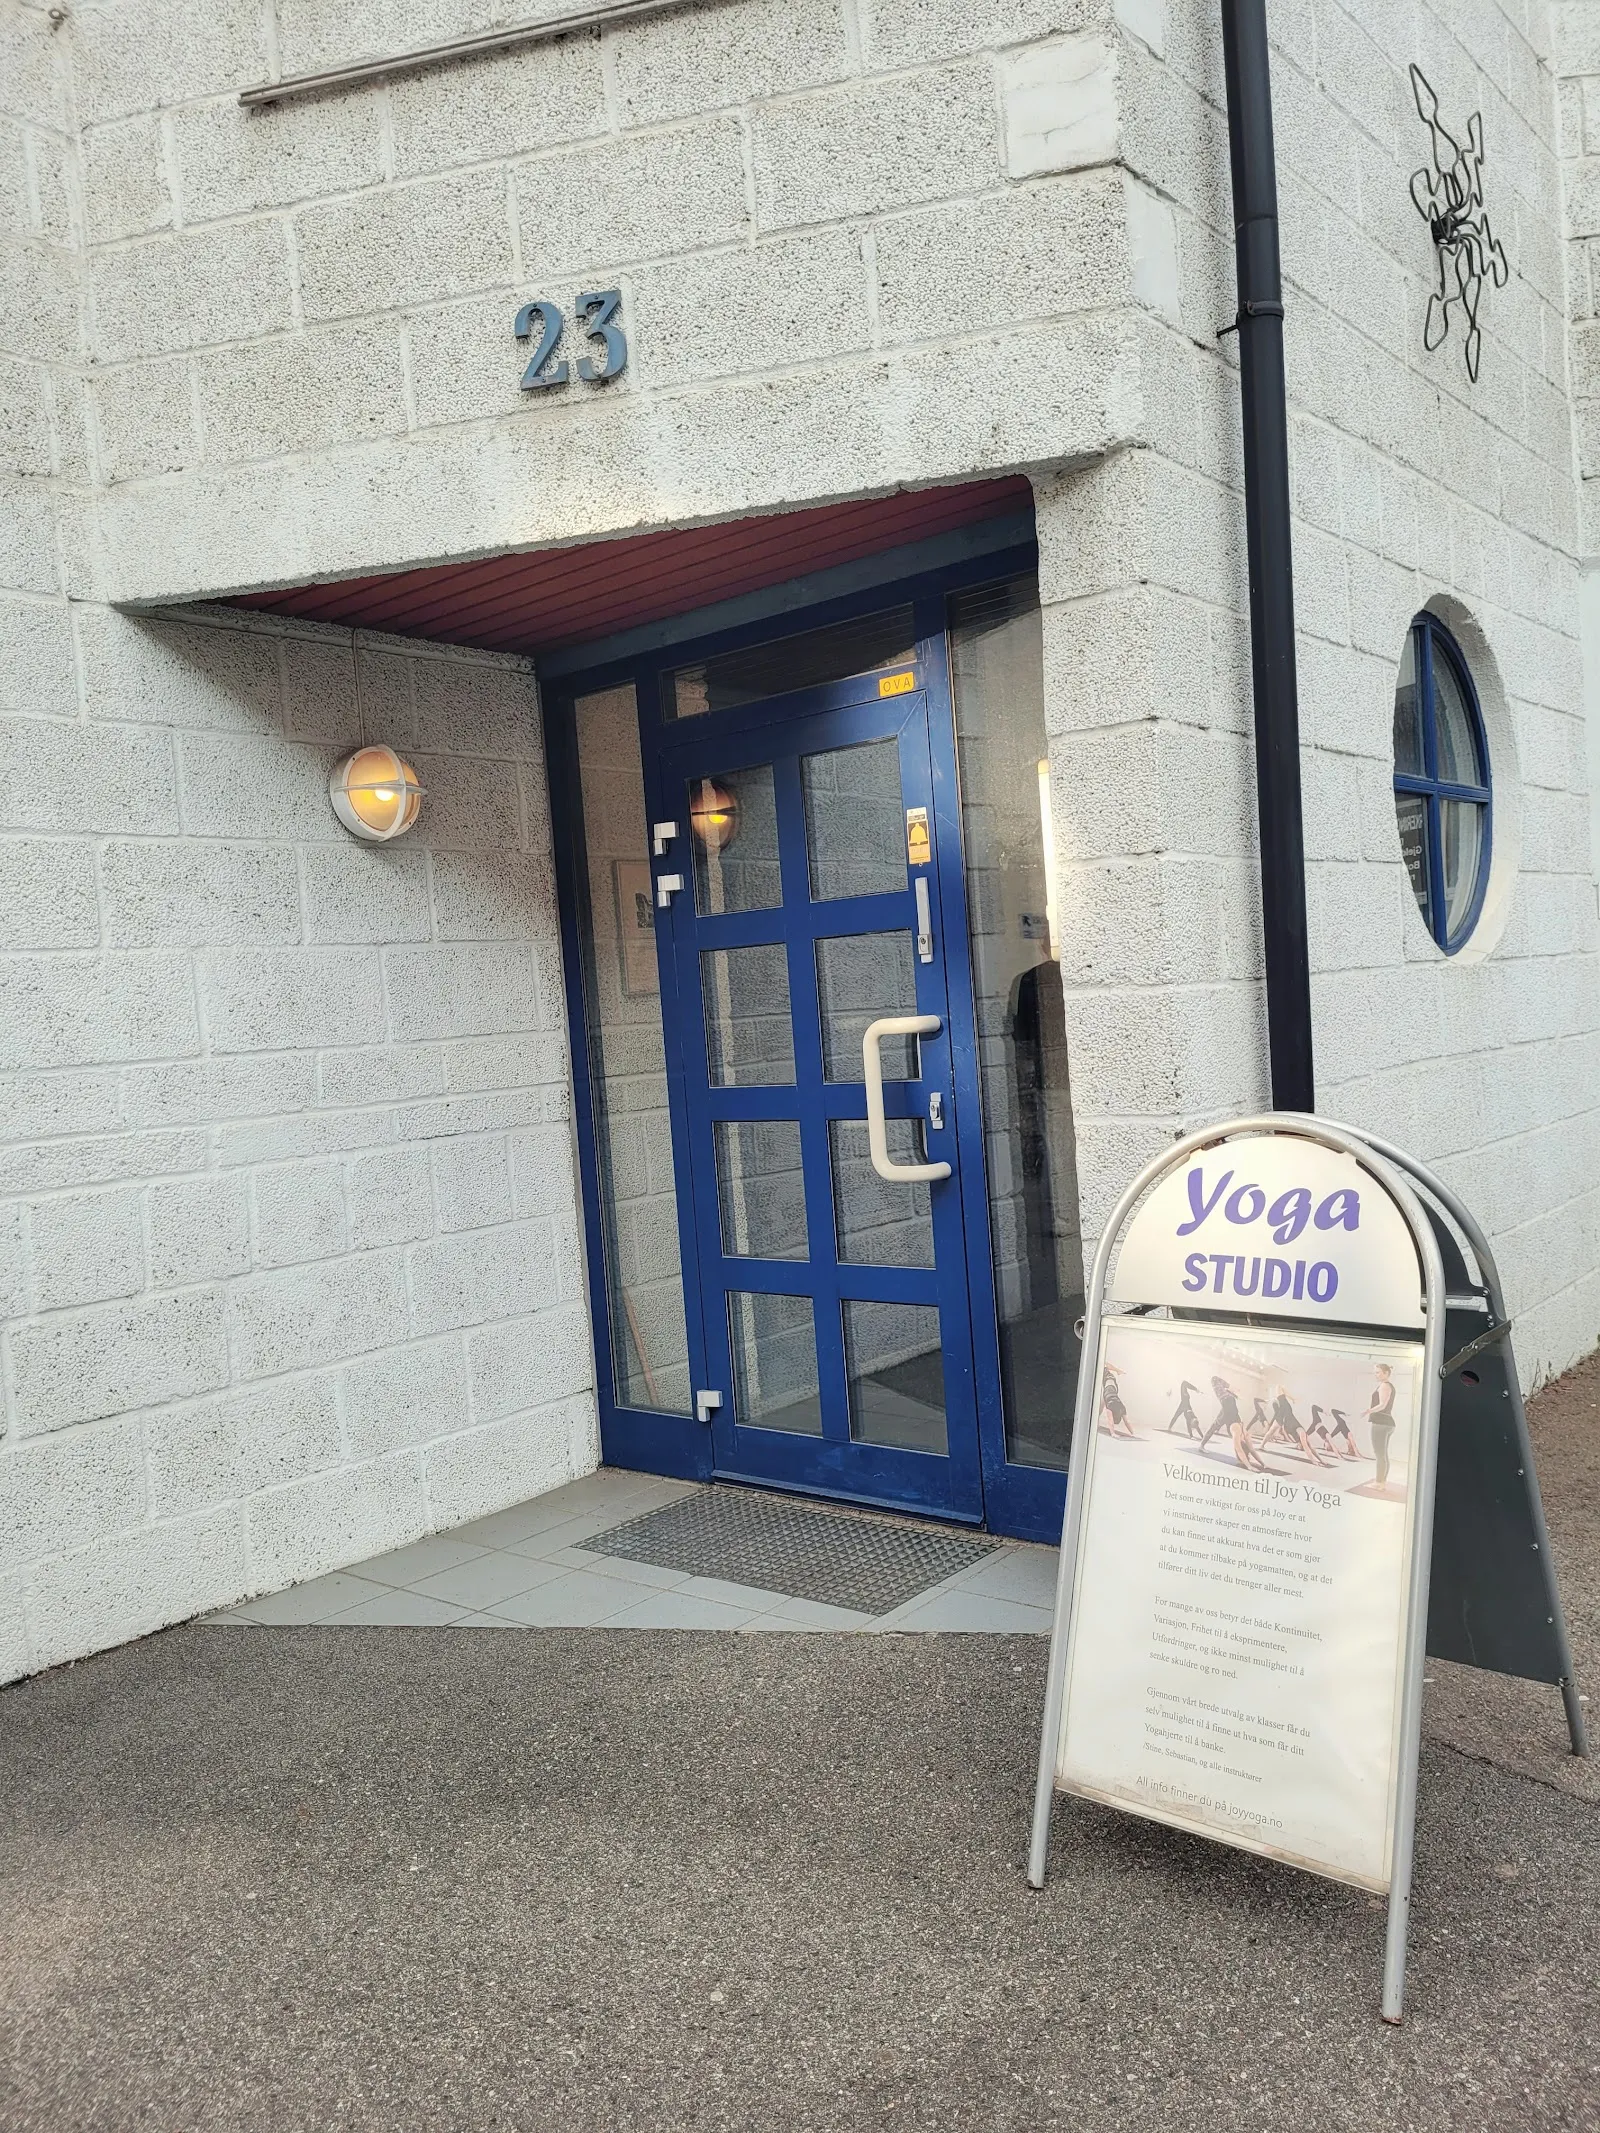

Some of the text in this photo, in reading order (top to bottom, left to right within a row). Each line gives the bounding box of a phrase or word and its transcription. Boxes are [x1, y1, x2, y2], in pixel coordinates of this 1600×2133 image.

[515, 290, 627, 391] 23
[883, 677, 910, 692] OVA
[1176, 1167, 1360, 1245] Yoga
[1182, 1253, 1338, 1302] STUDIO
[1163, 1463, 1342, 1509] Velkommen til Joy Yoga
[1165, 1490, 1177, 1500] Det
[1179, 1494, 1194, 1503] som
[1205, 1498, 1232, 1510] viktigst
[1234, 1503, 1245, 1512] for
[1261, 1508, 1271, 1517] på
[1272, 1509, 1286, 1520] Joy
[1163, 1508, 1312, 1542] vi instruktører skaper en atmosfære hvor
[1161, 1526, 1170, 1534] du
[1172, 1527, 1185, 1537] kan
[1187, 1530, 1206, 1541] finne
[1207, 1535, 1215, 1543] ut
[1217, 1536, 1245, 1549] akkurat
[1246, 1541, 1260, 1551] hva
[1262, 1544, 1274, 1554] det
[1286, 1551, 1302, 1559] som
[1304, 1553, 1321, 1563] gjør
[1158, 1560, 1183, 1573] tilfører
[1184, 1566, 1197, 1576] ditt
[1198, 1569, 1209, 1578] liv
[1210, 1571, 1222, 1581] det
[1223, 1574, 1233, 1583] du
[1235, 1577, 1262, 1590] trenger
[1263, 1582, 1282, 1593] aller
[1168, 1545, 1178, 1553] du
[1179, 1547, 1209, 1560] kommer
[1211, 1553, 1236, 1565] tilbake
[1237, 1559, 1247, 1568] på
[1298, 1572, 1309, 1581] og
[1310, 1574, 1318, 1582] at
[1320, 1575, 1333, 1585] det
[1155, 1596, 1168, 1606] For
[1169, 1600, 1193, 1613] mange
[1205, 1609, 1218, 1618] oss
[1219, 1610, 1239, 1623] betyr
[1240, 1616, 1252, 1626] det
[1254, 1618, 1272, 1630] både
[1191, 1622, 1213, 1635] Frihet
[1214, 1628, 1222, 1638] til
[1149, 1651, 1170, 1663] senke
[1171, 1656, 1198, 1670] skuldre
[1199, 1665, 1210, 1674] og
[1211, 1667, 1220, 1675] ro
[1199, 1646, 1209, 1655] og
[1211, 1646, 1227, 1657] ikke
[1229, 1652, 1251, 1663] minst
[1253, 1657, 1288, 1671] mulighet
[1289, 1665, 1298, 1675] til
[1146, 1686, 1311, 1738] Gjennom vårt brede utvalg av klasser får du
[1144, 1722, 1183, 1741] Yogahjerte
[1185, 1734, 1193, 1745] til
[1145, 1706, 1161, 1716] selv
[1161, 1710, 1195, 1725] mulighet
[1196, 1719, 1204, 1728] til
[1212, 1723, 1232, 1736] finne
[1233, 1730, 1241, 1739] ut
[1243, 1730, 1257, 1743] hva
[1259, 1737, 1275, 1748] som
[1277, 1741, 1289, 1752] får
[1290, 1744, 1305, 1756] ditt
[1199, 1759, 1208, 1768] og
[1209, 1760, 1222, 1771] alle
[1223, 1764, 1263, 1783] instruktører
[1136, 1776, 1283, 1829] All info finner du på joyyoga.no
